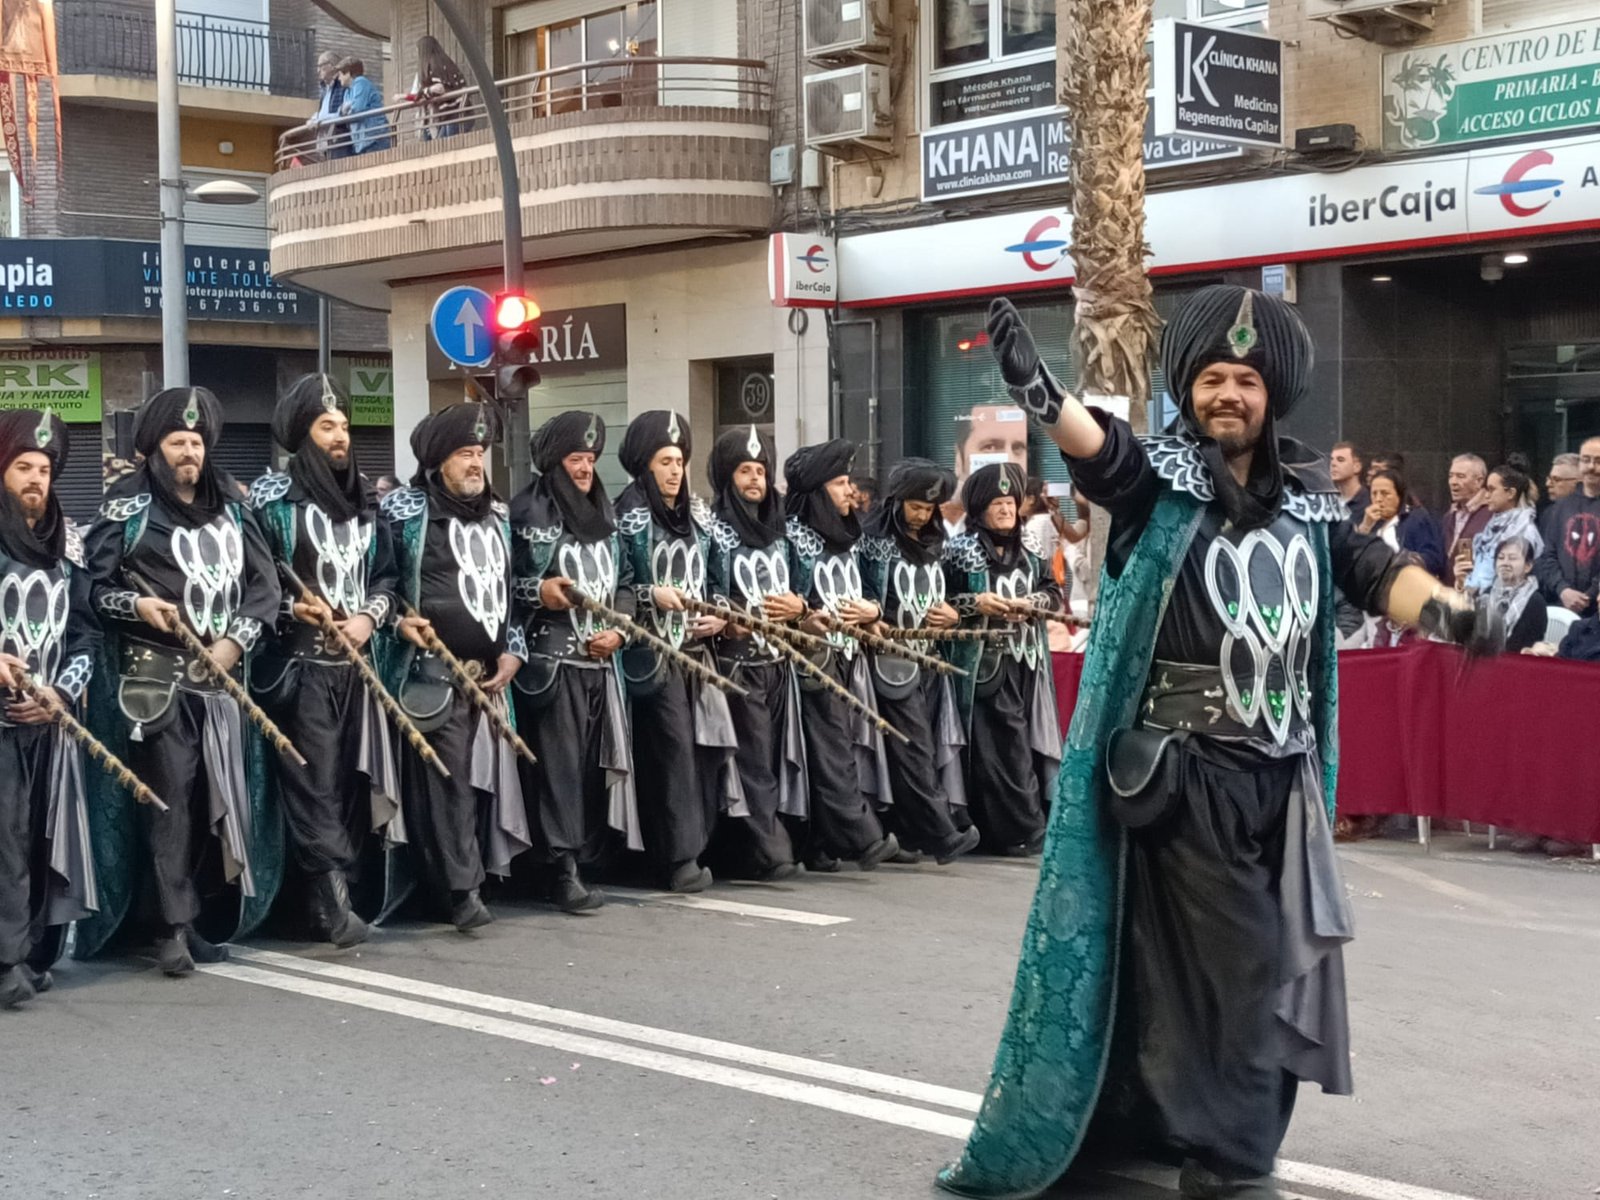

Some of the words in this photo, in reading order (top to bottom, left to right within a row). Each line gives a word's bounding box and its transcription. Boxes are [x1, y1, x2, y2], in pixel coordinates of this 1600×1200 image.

[1462, 35, 1549, 72] CENTRO
[1556, 29, 1587, 57] DE
[1208, 50, 1245, 70] CLÍNICA
[1245, 57, 1278, 75] KHANA
[962, 79, 999, 94] Método
[1000, 74, 1032, 87] Khana
[1494, 72, 1577, 101] PRIMARIA
[942, 98, 956, 107] sin
[958, 90, 1001, 105] fármacos
[1006, 87, 1016, 96] ni
[963, 96, 1031, 114] naturalmente
[1234, 94, 1278, 114] Medicina
[1178, 107, 1243, 129] Regenerativa
[1245, 117, 1278, 135] Capilar
[1458, 108, 1525, 134] ACCESO
[1528, 98, 1591, 125] CICLOS
[928, 126, 1040, 178] KHANA
[936, 169, 1032, 191] www.clinicakhana.com
[1308, 180, 1456, 227] iberCaja
[143, 268, 218, 285] VINTE
[796, 280, 831, 294] iberCaja
[32, 390, 91, 400] NATURAL
[32, 402, 82, 410] GRATUITO
[746, 384, 765, 406] 39
